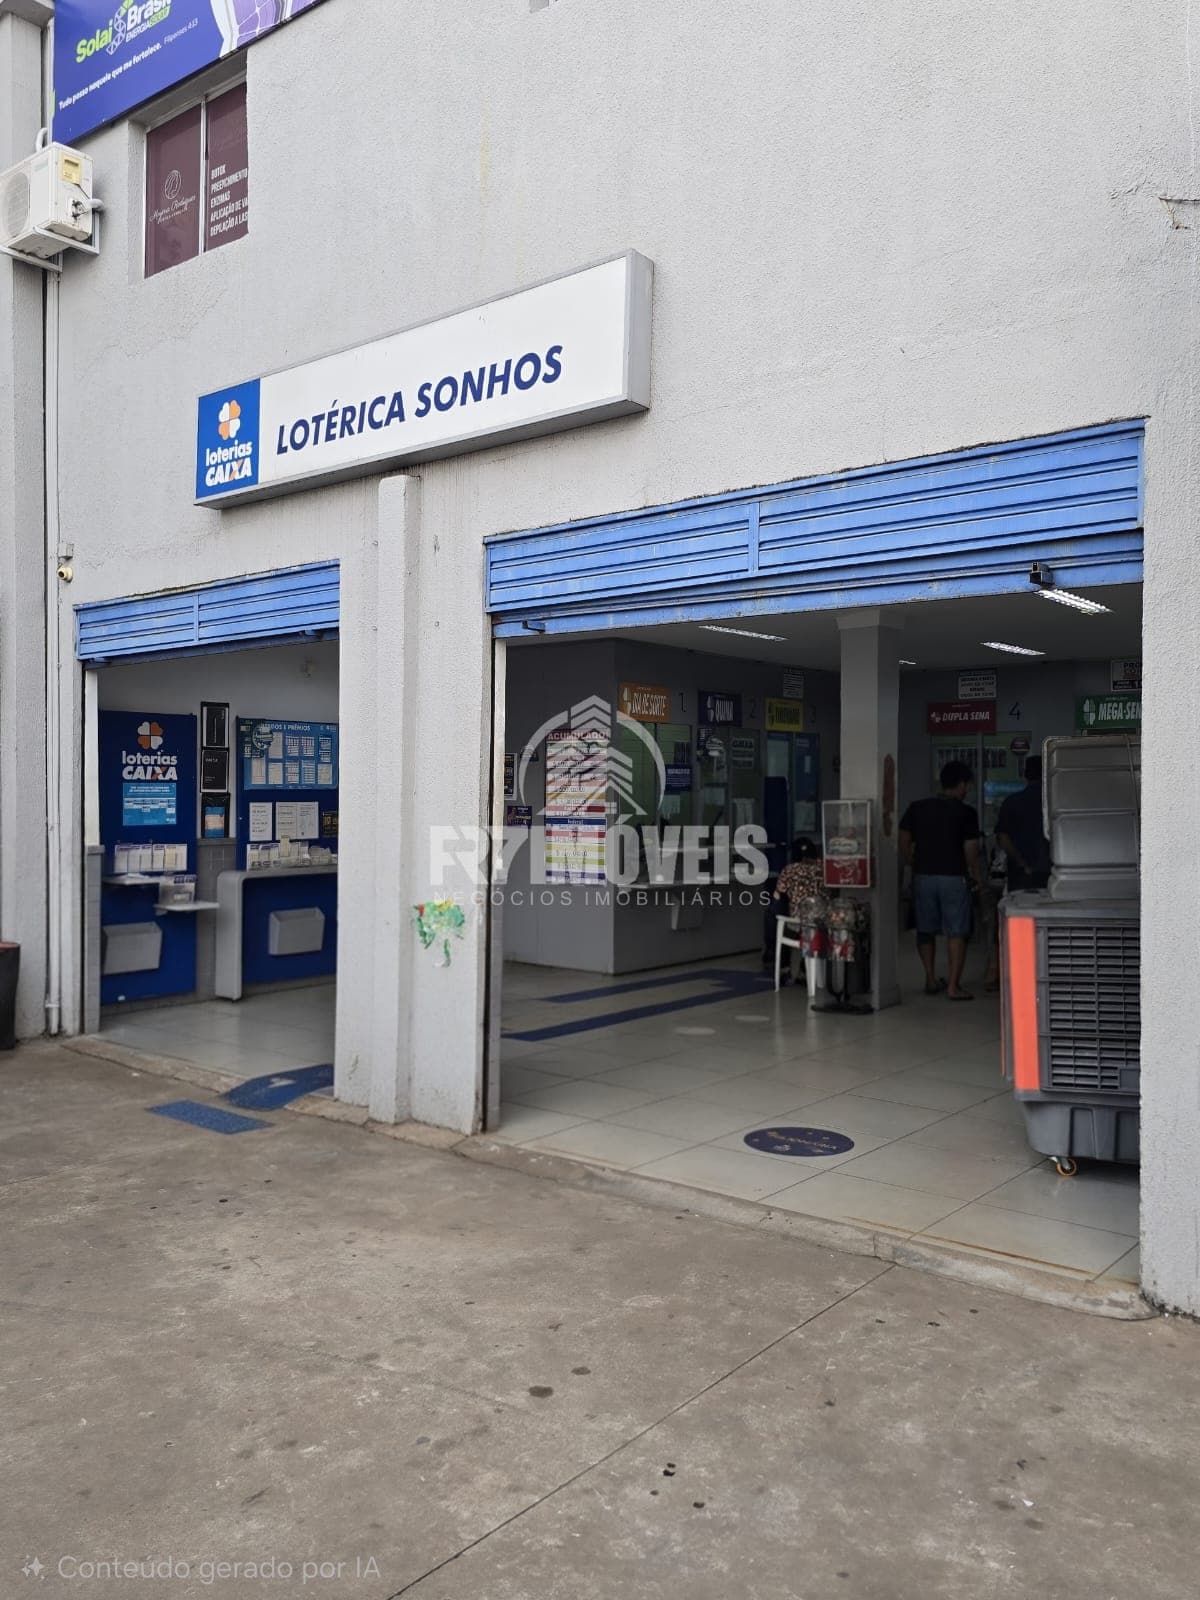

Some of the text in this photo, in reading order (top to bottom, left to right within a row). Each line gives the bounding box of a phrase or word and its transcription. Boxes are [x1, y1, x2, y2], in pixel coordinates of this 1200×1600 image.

[59, 97, 73, 110] Tudo
[72, 87, 89, 104] posso
[88, 72, 111, 92] naquele
[112, 66, 123, 79] que
[123, 60, 132, 71] me
[132, 43, 161, 64] fortalece.
[210, 202, 235, 222] APLICAÇÃO
[235, 200, 242, 211] DE
[210, 217, 235, 237] DEPILAÇÃO
[276, 344, 562, 456] LOTÉRICA SONHOS
[205, 438, 253, 467] loterias
[205, 457, 253, 487] CAIXA
[715, 698, 734, 722] QUINA
[942, 711, 990, 721] DUPLA SENA
[1008, 702, 1020, 720] 4
[121, 749, 178, 765] loterias
[122, 765, 178, 781] CAIXA
